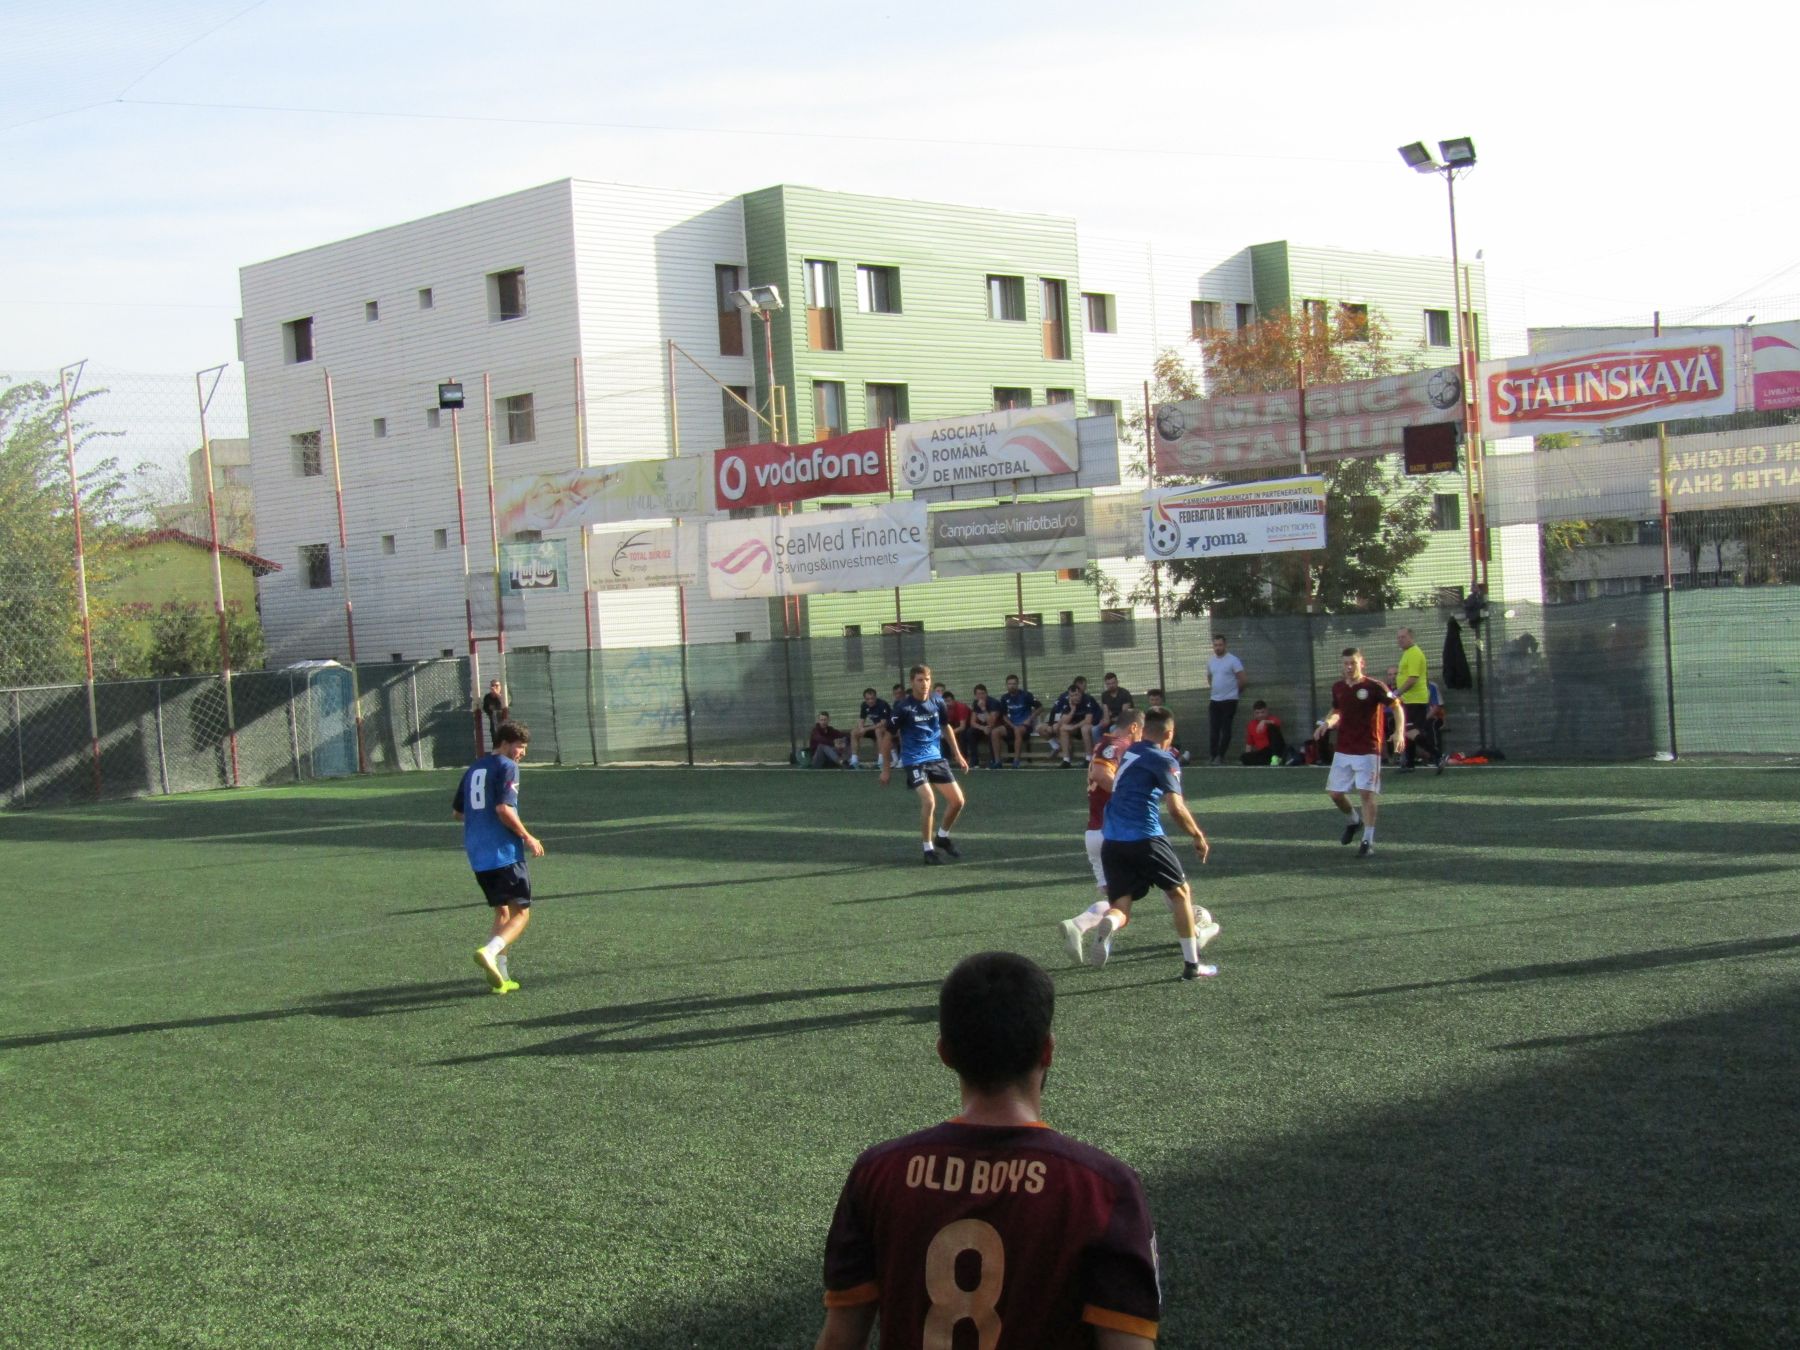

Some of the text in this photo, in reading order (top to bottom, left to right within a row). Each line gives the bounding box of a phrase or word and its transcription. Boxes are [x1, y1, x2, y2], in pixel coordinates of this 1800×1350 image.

[1497, 354, 1719, 416] STALINSKAYA
[1212, 379, 1399, 432] MAGIC
[755, 448, 880, 487] vodafone
[932, 441, 988, 462] ROMÂNĂ
[933, 460, 1030, 482] DE MINIFOTBAL
[939, 513, 1078, 540] CampionateMinifotbal.ro
[1216, 507, 1226, 520] DE
[1227, 503, 1268, 519] MINIFOTBAL
[1270, 502, 1282, 516] DIN
[630, 551, 648, 561] TOTAL
[775, 525, 921, 556] SeaMed Finance
[777, 552, 899, 575] Savings&investments
[470, 768, 487, 810] 8
[1112, 751, 1141, 793] 7
[906, 1155, 1048, 1195] OLD BOYS
[922, 1218, 1006, 1350] 8
